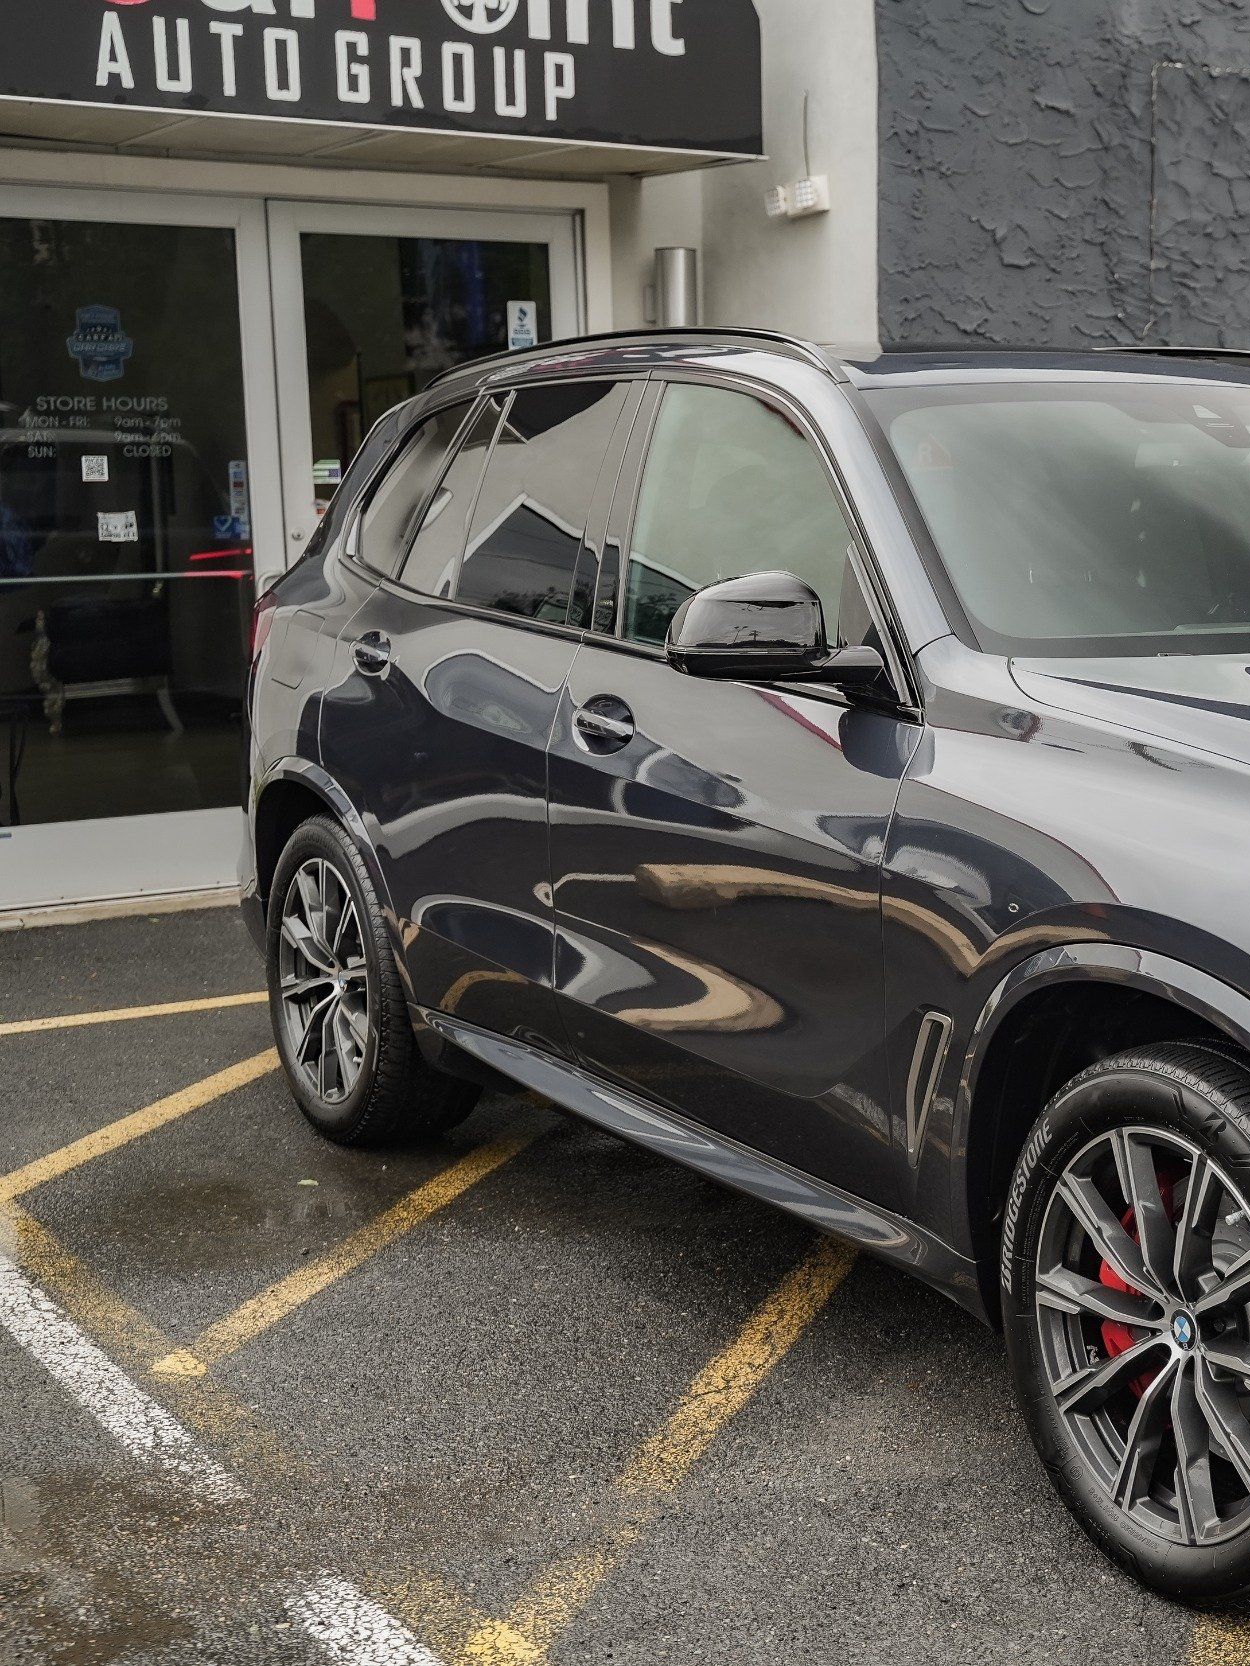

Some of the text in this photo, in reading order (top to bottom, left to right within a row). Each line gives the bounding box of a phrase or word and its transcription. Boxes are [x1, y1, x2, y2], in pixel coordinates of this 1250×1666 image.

[95, 10, 301, 102] AUTO
[334, 29, 576, 121] GROUP
[37, 396, 168, 411] STORE HOURS
[26, 416, 59, 428] MON
[122, 445, 172, 458] CLOSED
[1001, 1117, 1053, 1294] BRIDGESTONE
